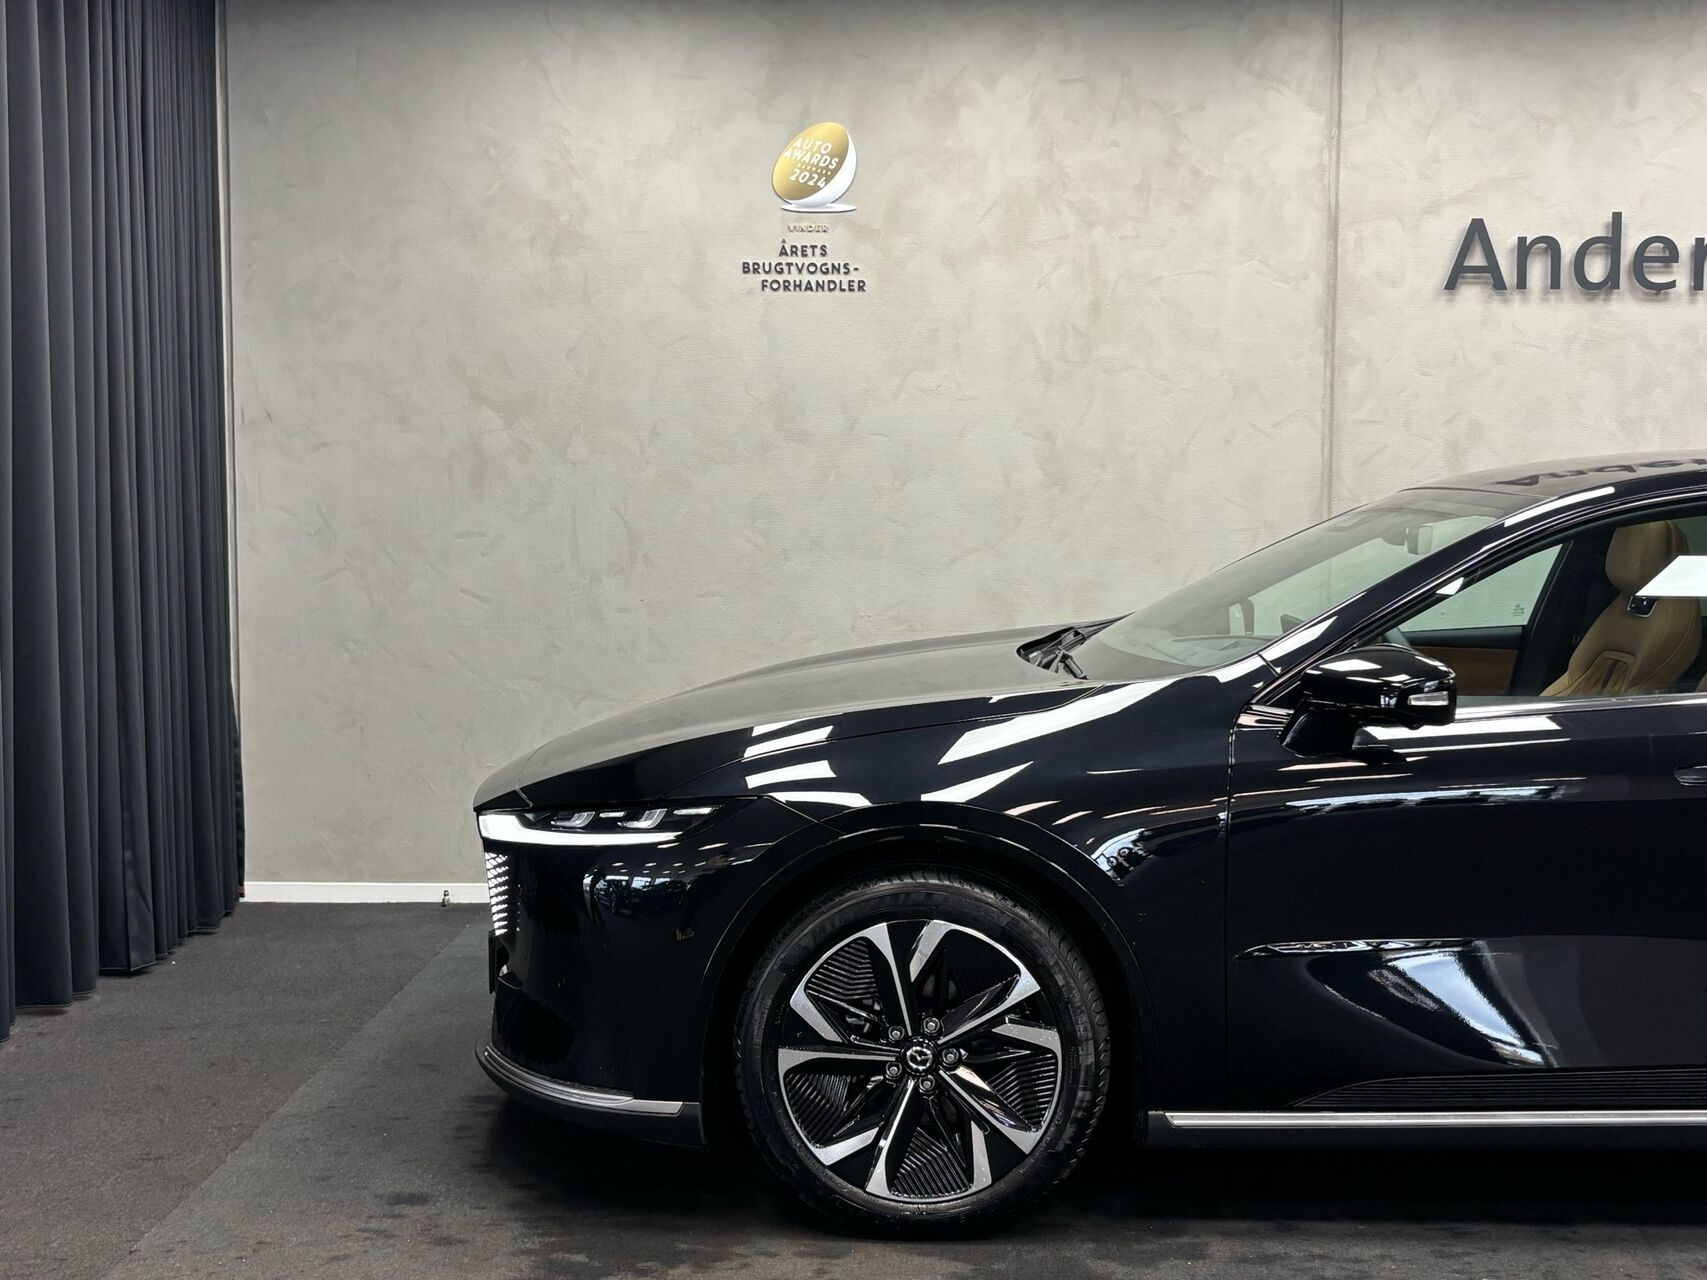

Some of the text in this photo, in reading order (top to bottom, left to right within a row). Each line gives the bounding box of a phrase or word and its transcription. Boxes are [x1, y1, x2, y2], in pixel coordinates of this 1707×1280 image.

[792, 137, 832, 155] AUTO
[783, 147, 840, 170] AWARDS
[789, 168, 827, 189] 2024
[778, 238, 828, 257] ÅRETS
[742, 261, 860, 275] BRUGTVOGNS-
[761, 279, 867, 293] FORHANDLER
